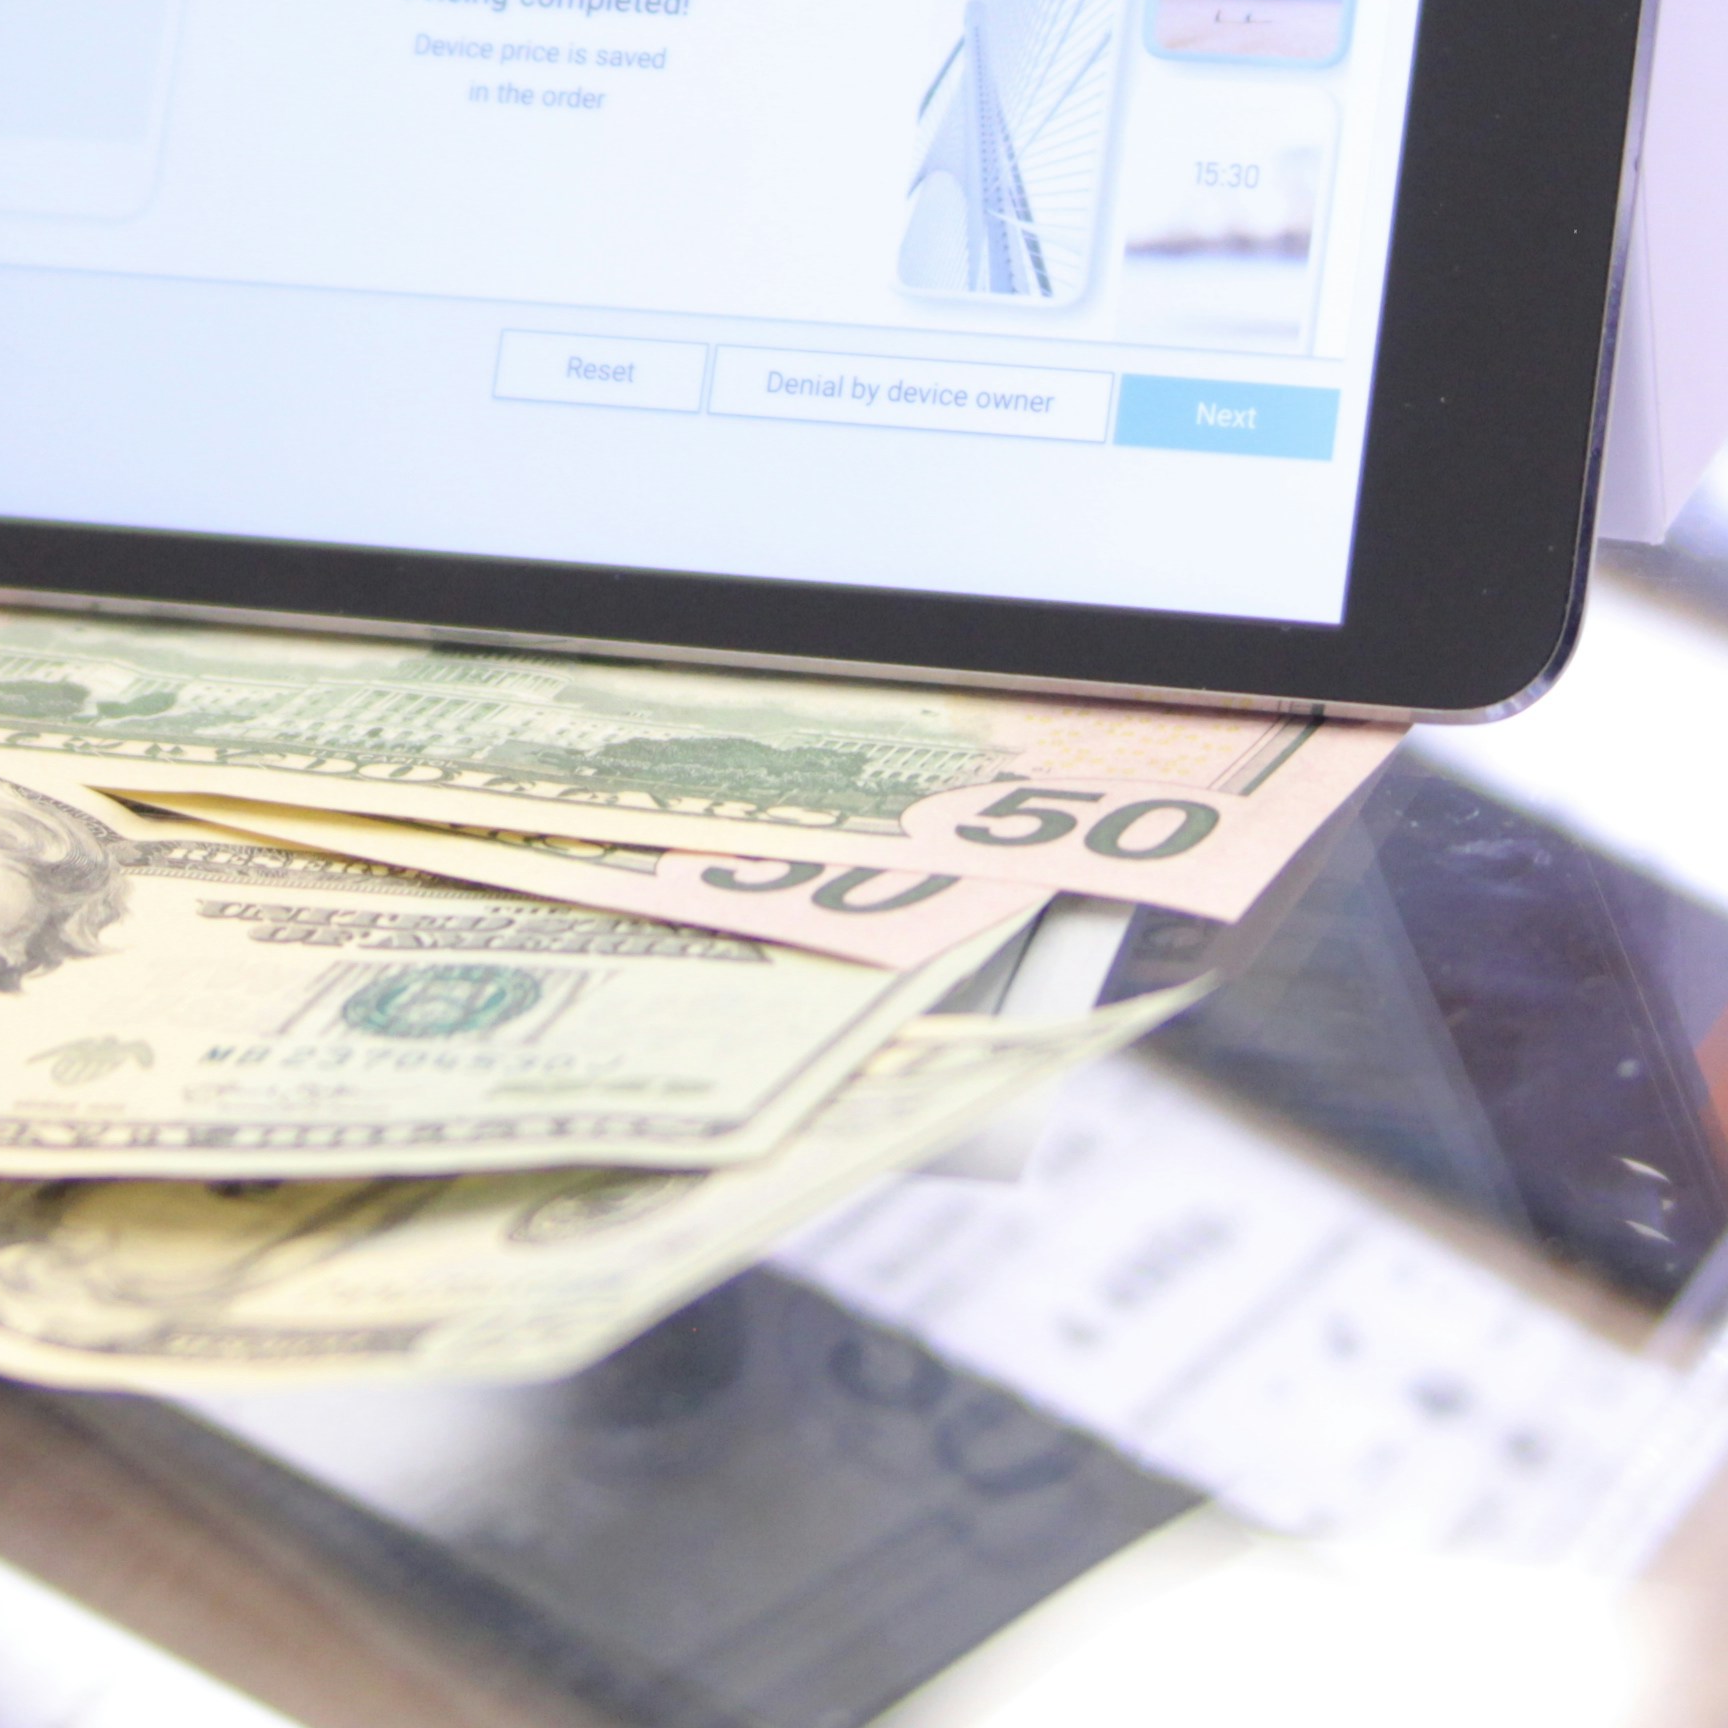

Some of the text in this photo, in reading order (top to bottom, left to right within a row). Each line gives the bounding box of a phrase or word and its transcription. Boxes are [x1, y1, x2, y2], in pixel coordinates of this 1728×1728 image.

[413, 33, 668, 71] Device price is saved
[468, 81, 607, 110] in the order
[1193, 158, 1262, 191] 15:30
[565, 355, 636, 384] Reset
[765, 369, 1057, 417] Denial by device owner
[1195, 399, 1258, 431] Next
[954, 787, 1221, 861] 50
